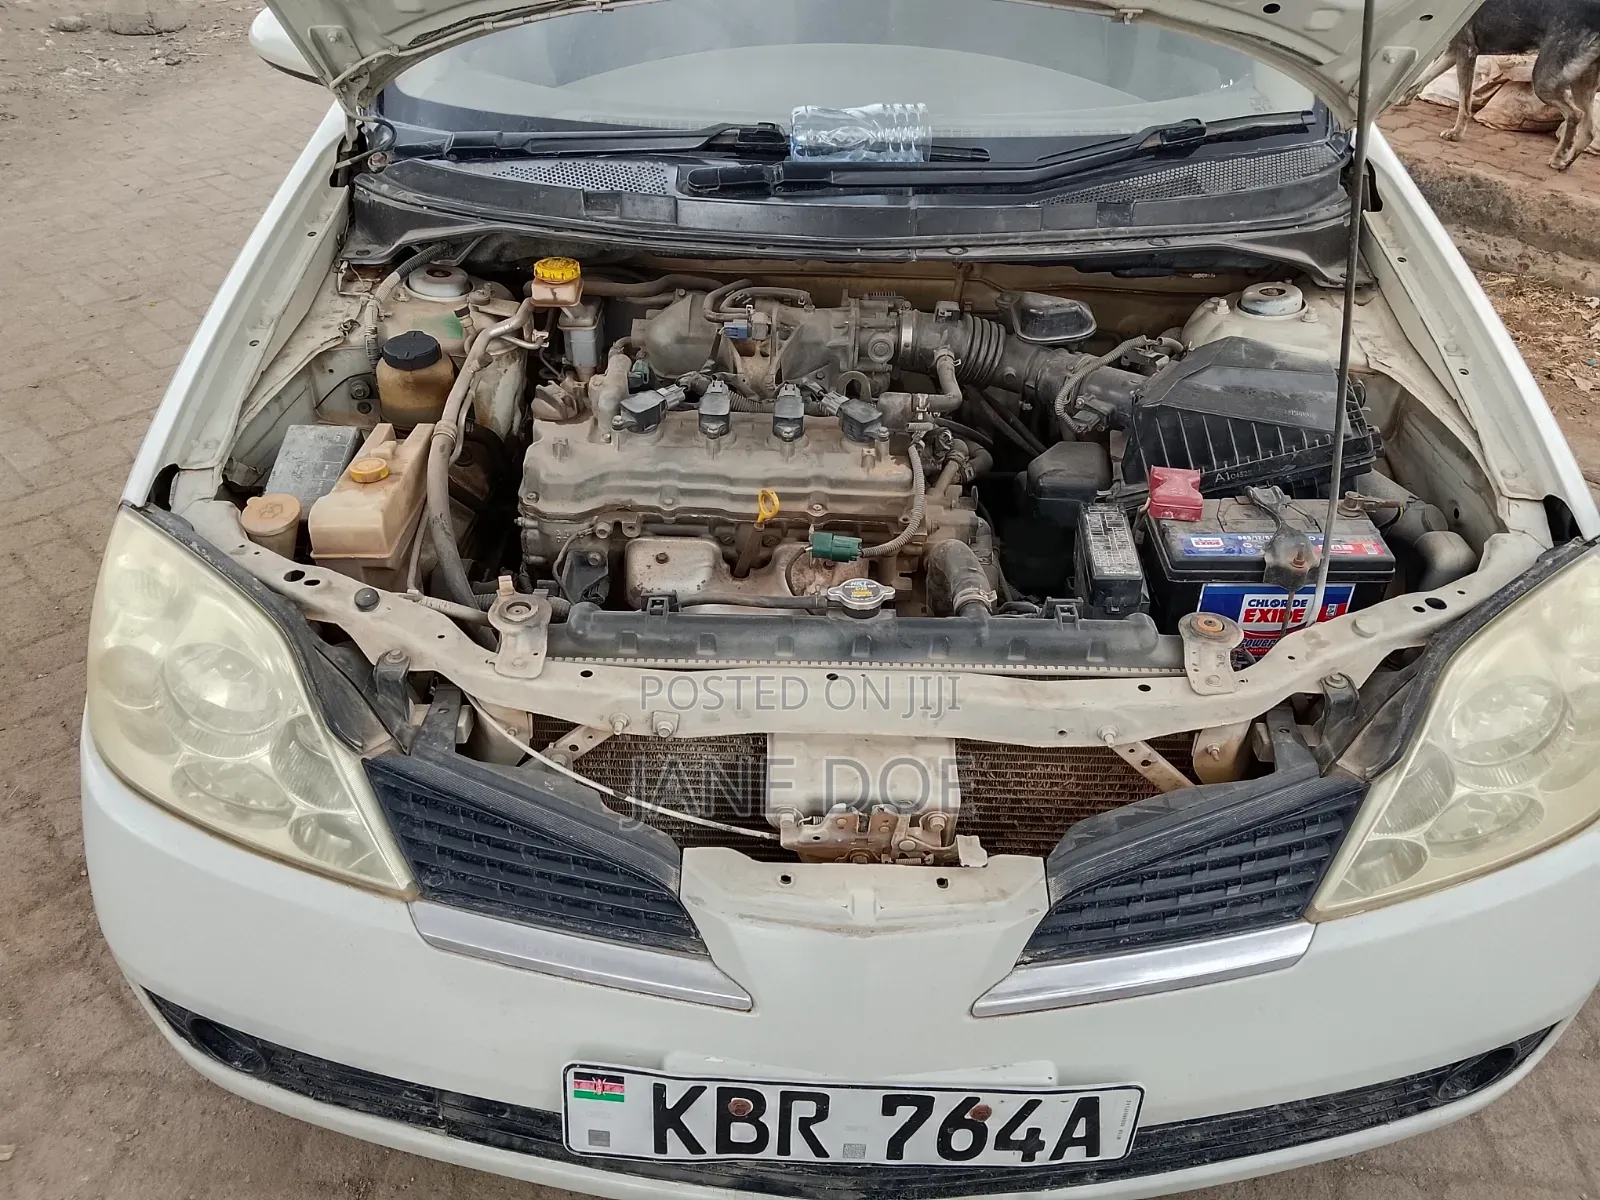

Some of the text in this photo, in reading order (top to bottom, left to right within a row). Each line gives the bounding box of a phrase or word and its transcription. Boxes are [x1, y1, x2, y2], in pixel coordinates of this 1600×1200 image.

[1248, 599, 1308, 607] CHLORDE
[1243, 608, 1306, 623] EXIDE
[1241, 638, 1280, 648] Power
[652, 1082, 831, 1159] KBR
[881, 1093, 1101, 1163] 764A
